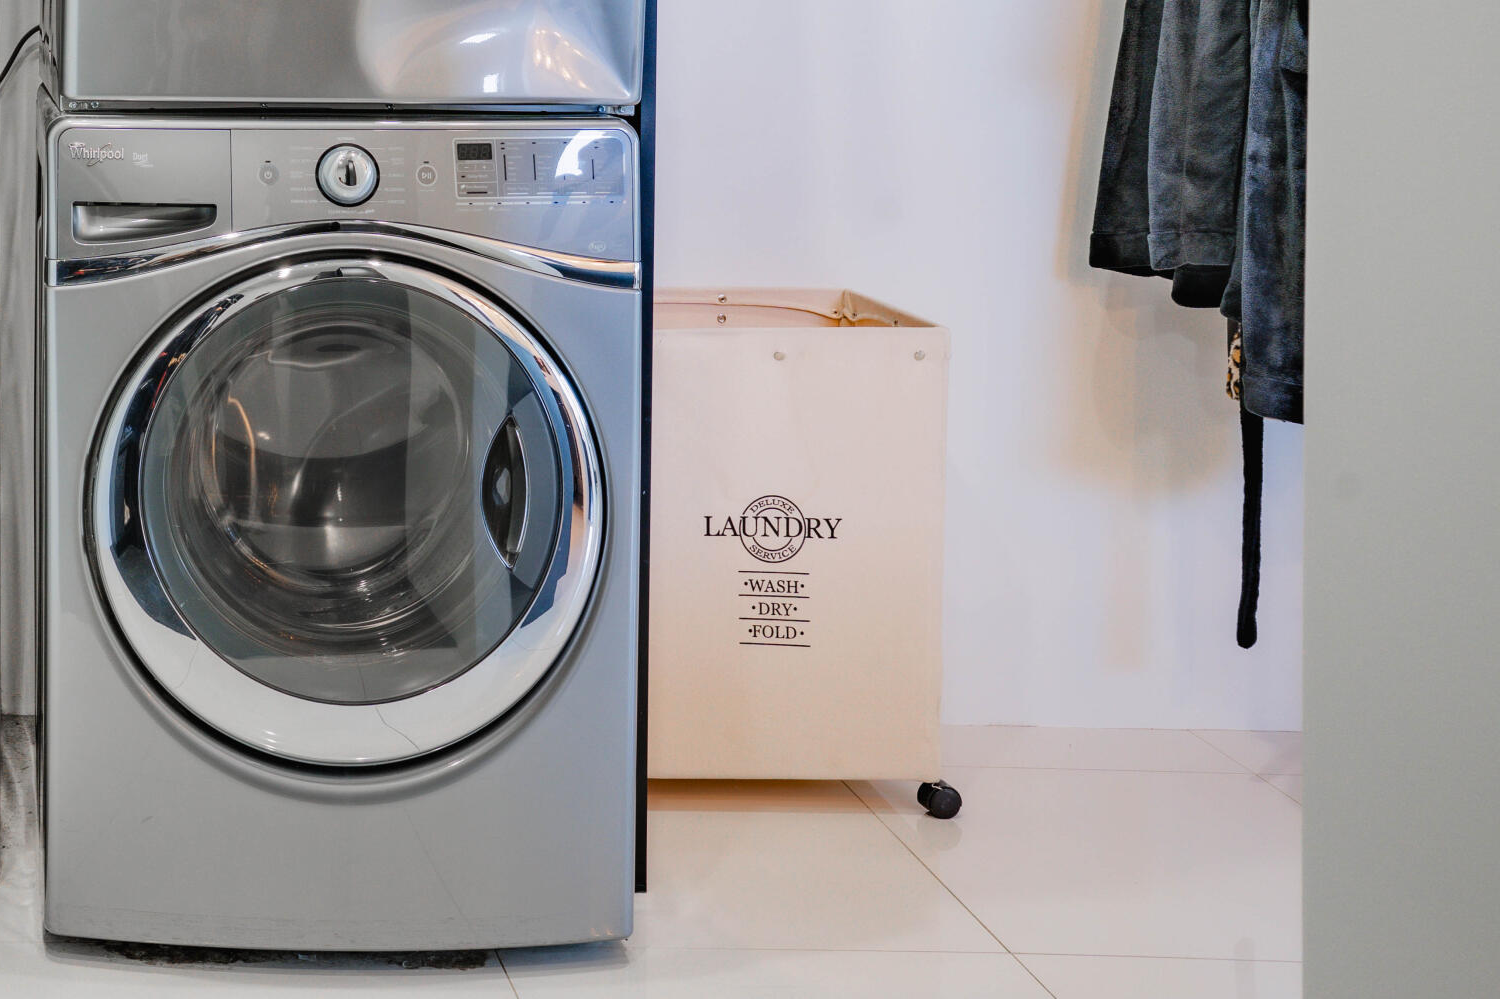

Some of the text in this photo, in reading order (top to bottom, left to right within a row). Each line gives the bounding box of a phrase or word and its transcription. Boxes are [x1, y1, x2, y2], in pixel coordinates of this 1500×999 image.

[68, 142, 125, 164] Whirlpool
[749, 498, 795, 515] DELUXE
[703, 515, 843, 539] LAUNDRY
[749, 543, 797, 560] SERVICE
